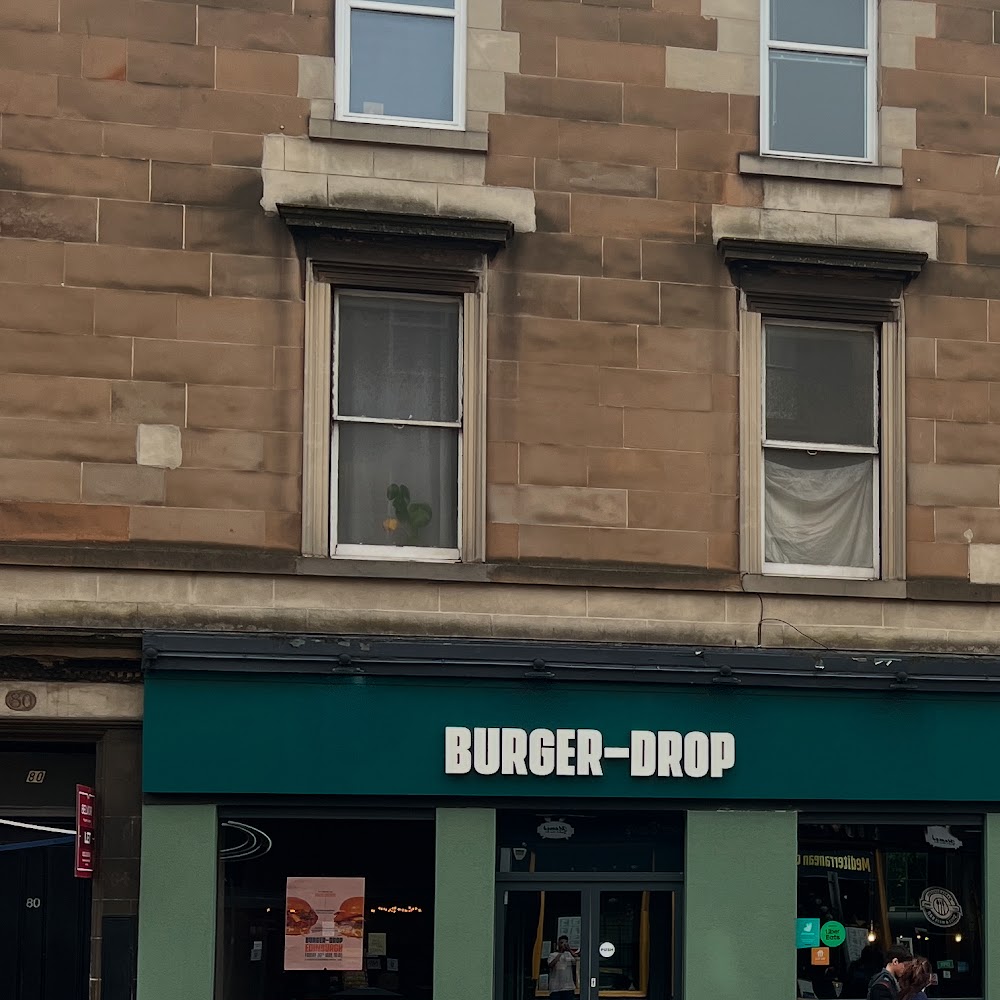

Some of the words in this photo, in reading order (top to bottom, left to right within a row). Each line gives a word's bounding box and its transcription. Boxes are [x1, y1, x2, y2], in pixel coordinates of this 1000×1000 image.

[10, 691, 32, 708] 80
[444, 726, 736, 778] BURGER-DROP
[29, 771, 43, 782] 80
[25, 897, 41, 909] 80
[305, 944, 343, 952] EDINBURGH
